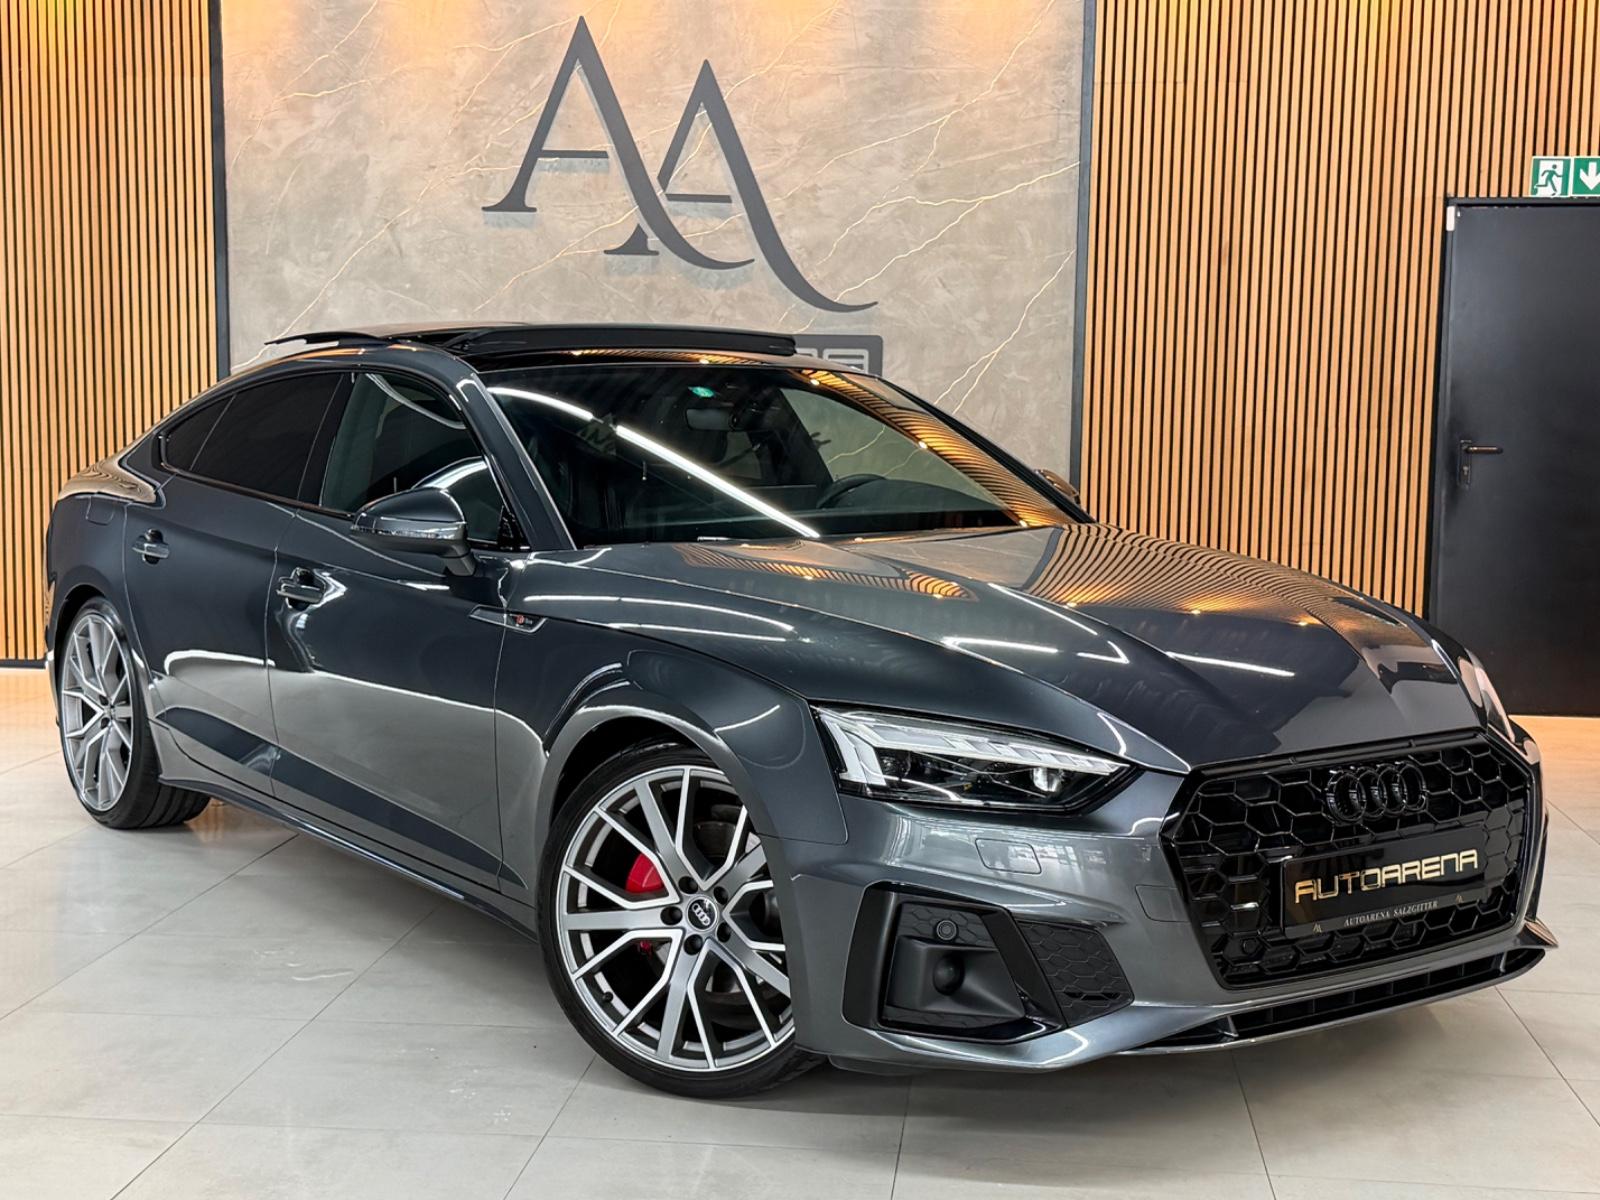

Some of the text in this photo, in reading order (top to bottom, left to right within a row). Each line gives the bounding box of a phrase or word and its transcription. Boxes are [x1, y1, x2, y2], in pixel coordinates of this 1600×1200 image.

[1294, 849, 1478, 904] AUTOARENA
[1343, 900, 1438, 927] AUTOARENA SALZGITTER
